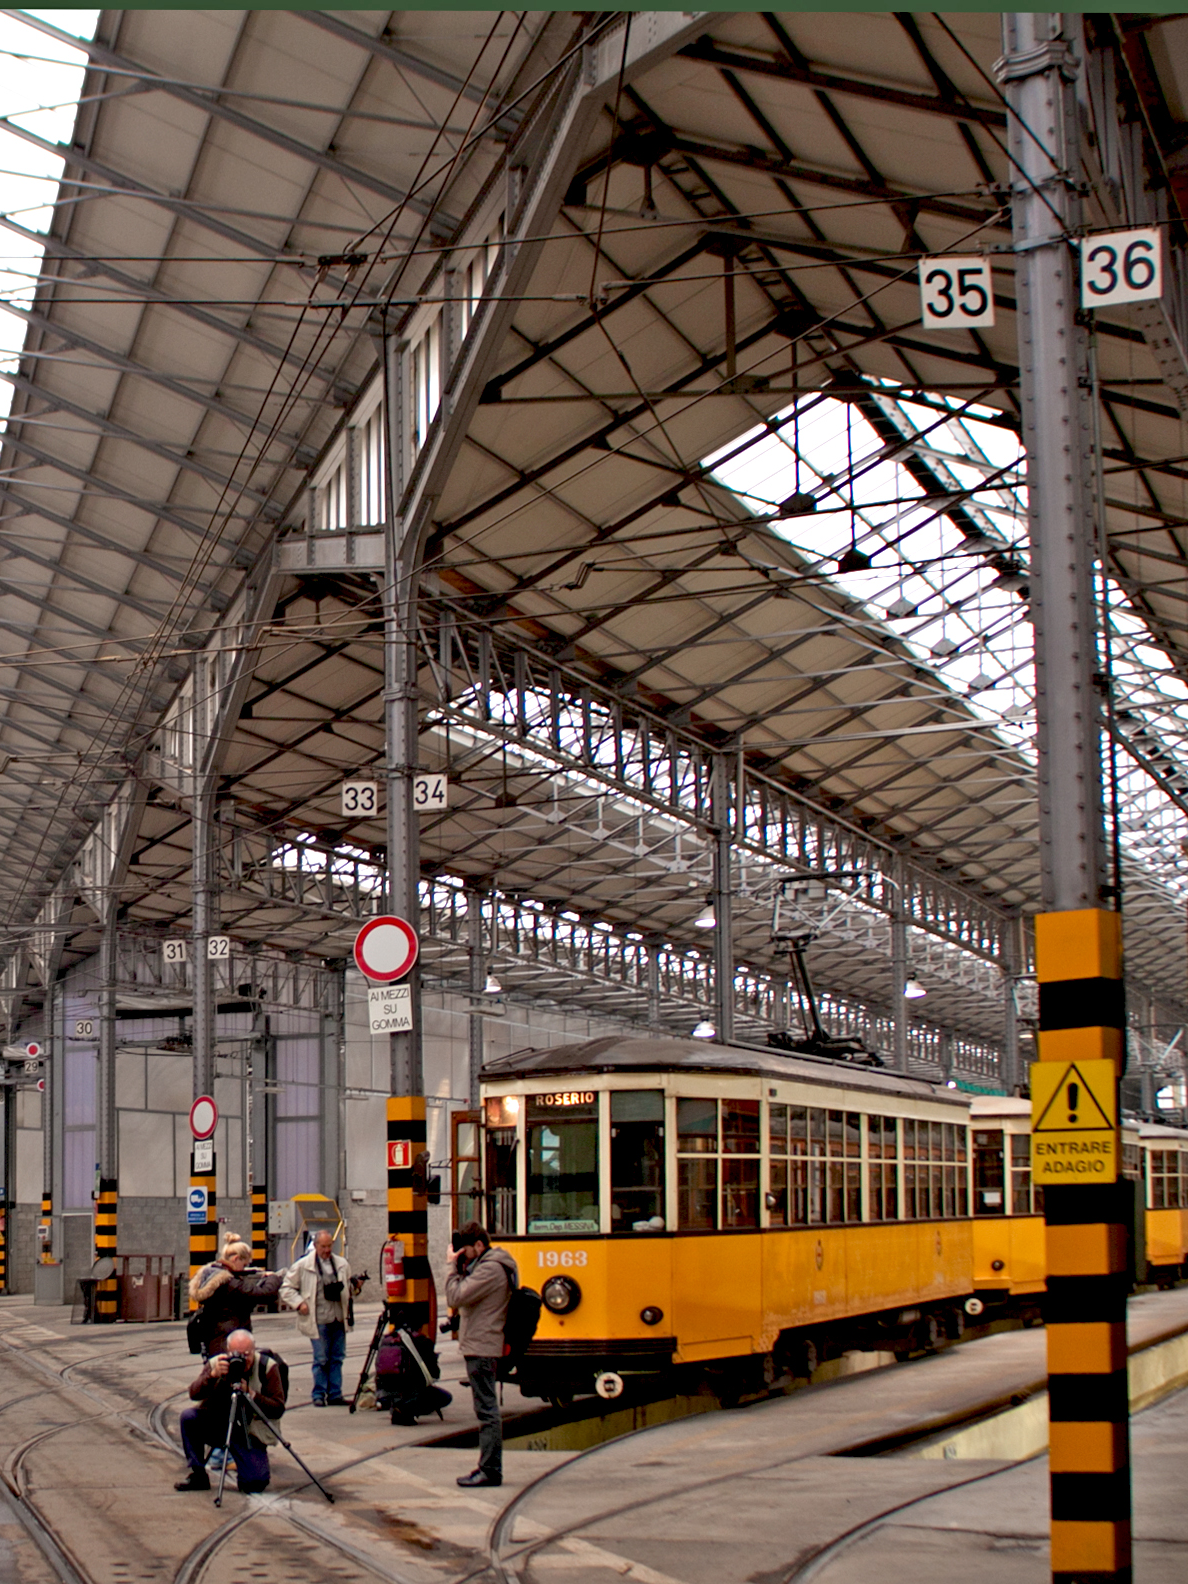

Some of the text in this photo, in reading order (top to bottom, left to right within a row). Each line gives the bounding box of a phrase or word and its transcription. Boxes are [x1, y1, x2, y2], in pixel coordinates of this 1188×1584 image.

[1087, 239, 1156, 296] 36
[924, 267, 989, 319] 35
[345, 786, 375, 811] 33
[415, 778, 445, 805] 34
[166, 942, 183, 959] 31
[209, 939, 228, 956] 32
[370, 987, 410, 1002] AI MEZZI
[383, 1003, 398, 1015] SU
[76, 1022, 93, 1035] 30
[372, 1016, 411, 1030] GOMMA
[25, 1061, 38, 1072] 29
[535, 1092, 595, 1107] ROSERIO
[1035, 1141, 1112, 1156] ENTRARE
[1042, 1159, 1105, 1174] ADAGIO
[537, 1250, 588, 1268] 1963
